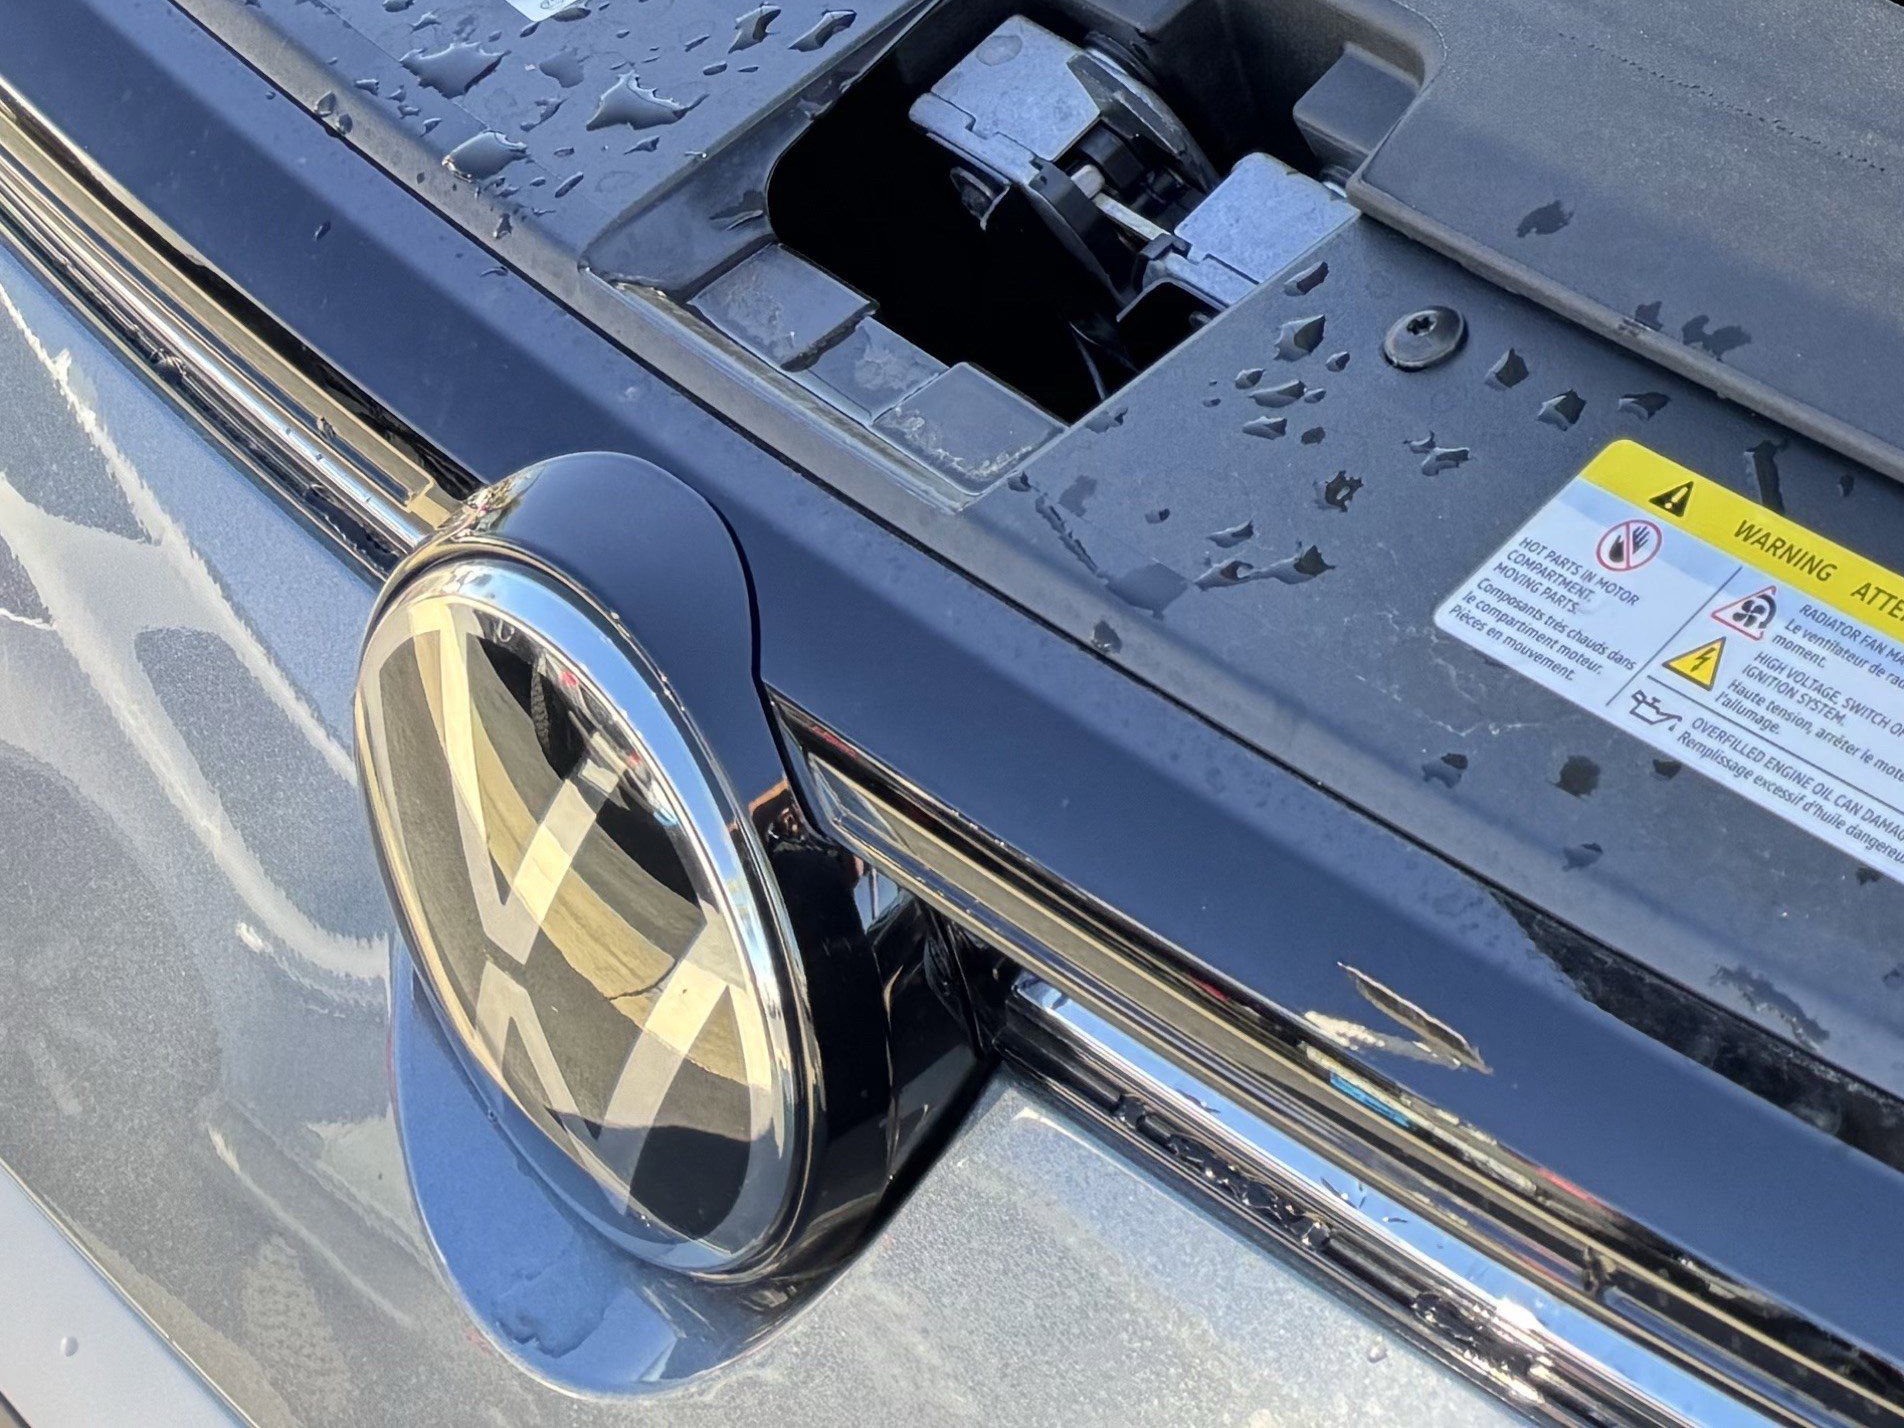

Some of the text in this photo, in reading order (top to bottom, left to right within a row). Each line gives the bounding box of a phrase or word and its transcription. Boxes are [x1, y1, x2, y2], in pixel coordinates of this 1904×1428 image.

[1503, 548, 1598, 603] COMPARTMENT.
[1516, 536, 1642, 606] HOT PARTS IN MOTOR
[1728, 519, 1840, 584] WARNING
[1490, 560, 1584, 615] MOVING PARTS.
[1447, 603, 1580, 682] Pièces en mouvement.
[1460, 590, 1607, 676] le compartiment moteur.
[1471, 576, 1640, 671] Composants très chauds dans
[1770, 632, 1831, 669] moment.
[1783, 618, 1806, 635] Le
[1799, 626, 1871, 669] ventilateur
[1865, 660, 1890, 678] de
[1797, 603, 1864, 642] RADIATOR
[1857, 634, 1889, 655] FAN
[1711, 690, 1786, 738] l'allumage.
[1725, 678, 1770, 707] Haute
[1761, 698, 1820, 736] tension,
[1813, 724, 1864, 757] arrêter
[1857, 748, 1878, 765] le
[1740, 662, 1851, 727] IGNITION SYSTEM.
[1752, 650, 1789, 675] HIGH
[1782, 666, 1846, 706] VOLTAGE,
[1838, 696, 1892, 730] SWITCH
[1672, 729, 1757, 784] Remplissage
[1750, 771, 1807, 808] excessif
[1799, 797, 1849, 831] d'huile
[1688, 716, 1767, 764] OVERFILLED
[1762, 755, 1815, 790] ENGINE
[1809, 781, 1838, 802] OIL
[1831, 792, 1865, 817] CAN
